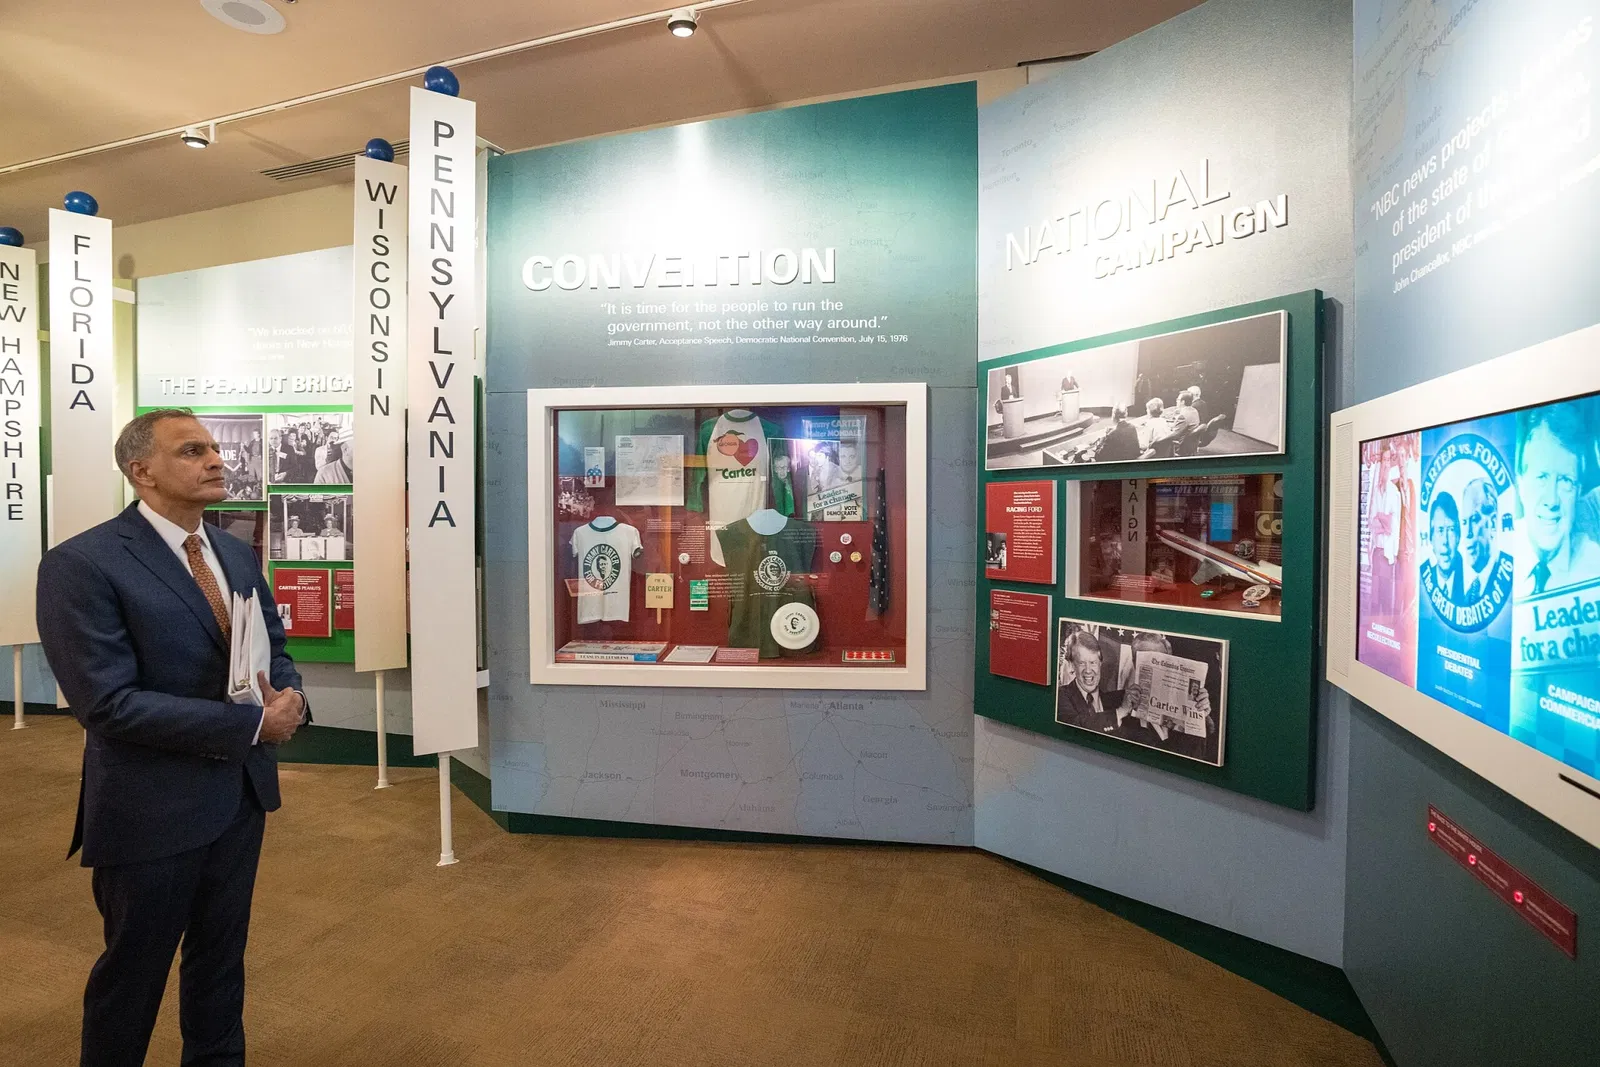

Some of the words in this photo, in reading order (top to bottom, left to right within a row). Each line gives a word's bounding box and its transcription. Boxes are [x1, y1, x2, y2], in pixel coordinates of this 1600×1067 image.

[1001, 138, 1033, 157] Toronto
[1402, 155, 1437, 196] news
[1441, 95, 1507, 169] projects
[1392, 211, 1405, 237] of
[1407, 198, 1428, 226] the
[1431, 164, 1469, 207] state
[1472, 139, 1491, 173] of
[1004, 157, 1231, 273] NATIONAL
[1092, 192, 1290, 280] CAMPAIGN
[1392, 213, 1452, 275] president
[1455, 191, 1473, 225] of
[521, 247, 837, 292] CONVENTION
[1392, 276, 1410, 294] John
[1451, 233, 1473, 258] NBC
[0, 262, 26, 323] NEW
[364, 179, 398, 417] WISCONSIN
[621, 303, 632, 315] is
[635, 302, 667, 315] time
[671, 301, 690, 314] for
[695, 300, 717, 313] the
[722, 299, 769, 315] people
[774, 300, 788, 312] to
[792, 301, 816, 312] run
[820, 298, 844, 311] the
[69, 234, 96, 412] FLORIDA
[427, 120, 457, 529] PENNSYLVANIA
[607, 320, 693, 336] government,
[698, 319, 721, 331] not
[726, 317, 748, 330] the
[752, 317, 790, 330] other
[793, 318, 824, 332] way
[827, 315, 889, 329] around.”
[607, 338, 632, 348] Jimmy
[633, 337, 658, 347] Carter,
[659, 336, 703, 347] Acceptance
[704, 336, 734, 347] Speech,
[735, 335, 779, 344] Democratic
[780, 334, 811, 344] National
[812, 334, 857, 344] Convention,
[858, 334, 875, 345] July
[877, 334, 888, 344] 15,
[889, 334, 909, 343] 1976
[158, 377, 197, 396] THE
[200, 375, 288, 395] PEANUT
[0, 337, 25, 521] HAMPSHIRE
[831, 419, 862, 428] CARTER
[722, 467, 757, 480] Carter
[1421, 443, 1457, 506] CARTER
[1474, 442, 1508, 487] FORD
[584, 546, 600, 567] JIMMY
[600, 544, 620, 566] CARTER
[584, 570, 595, 584] FOR
[1421, 565, 1434, 593] The
[1432, 586, 1455, 622] GREAT
[1456, 594, 1494, 627] DEBATES
[1492, 579, 1504, 605] of
[1436, 644, 1482, 671] PRESIDENTIAL
[1521, 636, 1545, 662] for
[1547, 640, 1562, 660] a
[1444, 660, 1474, 681] DEBATES
[599, 699, 647, 711] Mississippi
[674, 711, 724, 721] Birmingham
[828, 701, 864, 712] Atlanta
[1149, 695, 1180, 714] Carter
[1181, 704, 1204, 720] Wins
[859, 749, 888, 760] Macon
[582, 770, 622, 781] Jackson
[680, 768, 740, 782] Montgomery
[802, 771, 844, 782] Columbus
[862, 794, 899, 806] Georgia
